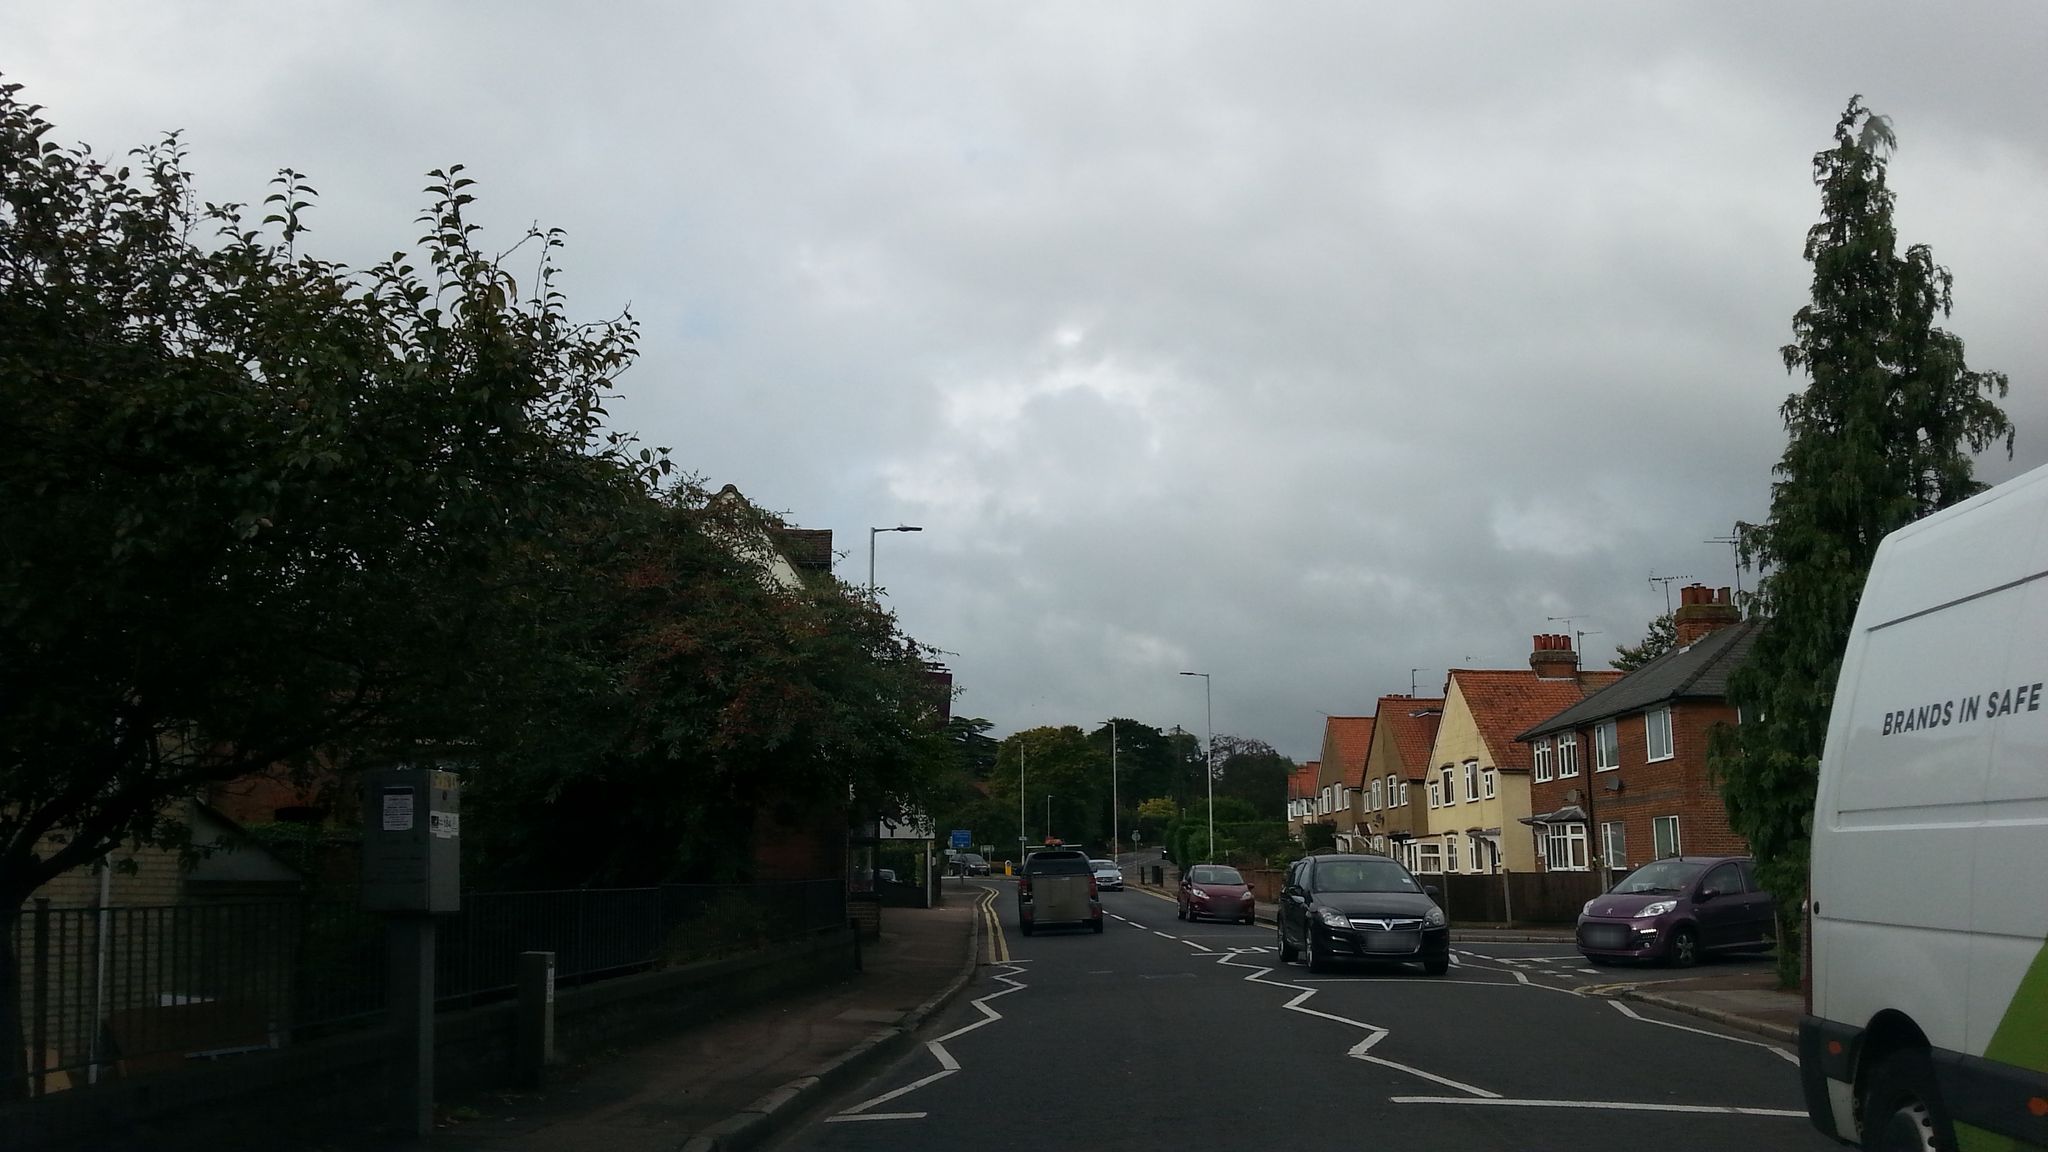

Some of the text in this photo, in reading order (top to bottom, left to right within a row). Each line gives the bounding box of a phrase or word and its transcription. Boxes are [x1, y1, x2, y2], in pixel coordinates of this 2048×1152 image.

[1882, 683, 2043, 736] BRANDS IN SAFE
